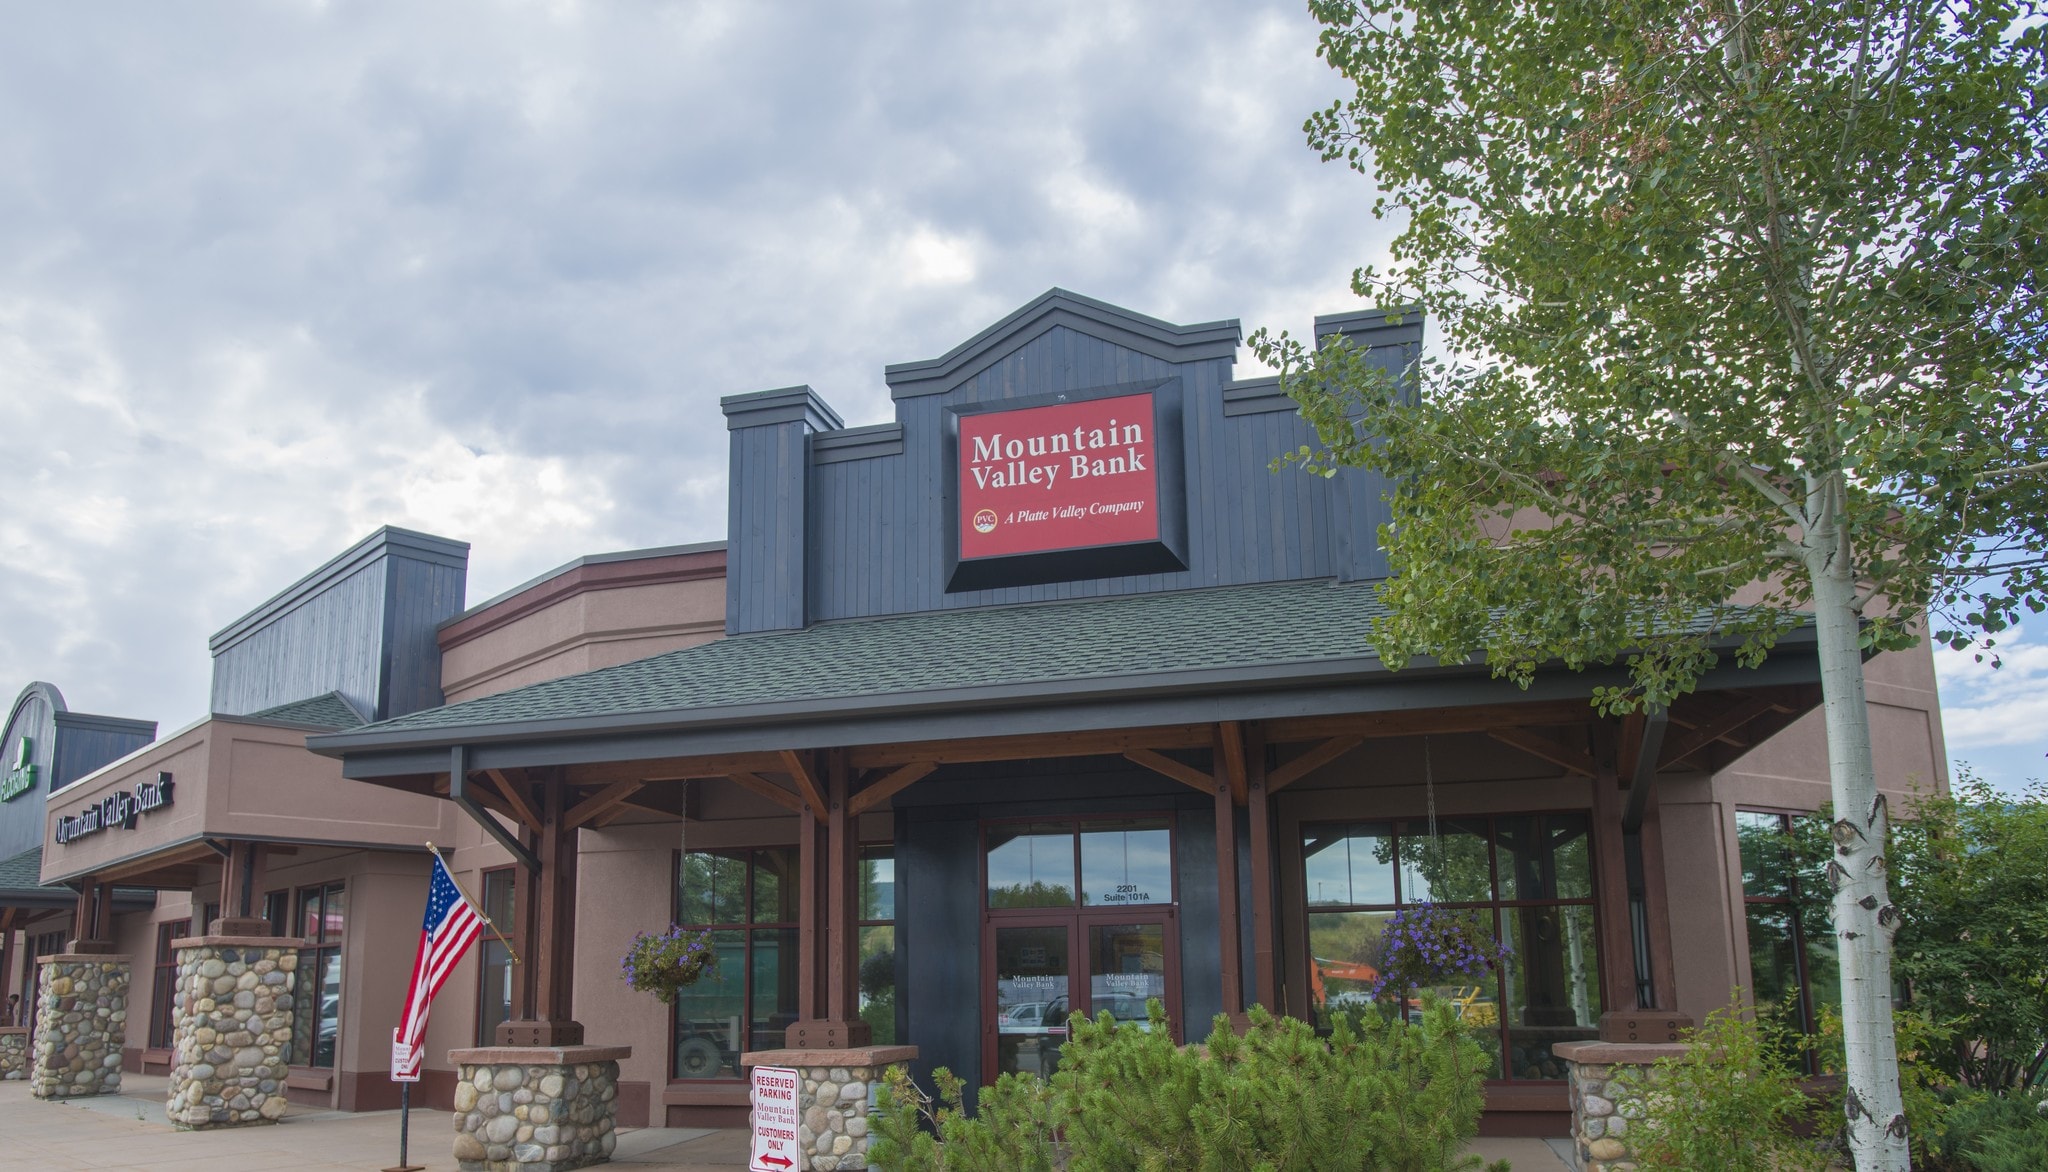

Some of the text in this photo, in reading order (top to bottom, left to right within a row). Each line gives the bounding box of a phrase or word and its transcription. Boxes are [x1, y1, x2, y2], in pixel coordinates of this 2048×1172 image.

[971, 419, 1144, 463] Mountain
[970, 447, 1147, 490] Valley Bank
[977, 514, 995, 524] PVC
[1004, 500, 1145, 524] A Platte Valley Company
[56, 771, 172, 844] Mountain Valley Bank
[1116, 884, 1138, 893] 2201
[1103, 892, 1150, 902] Suite 101A
[1012, 974, 1054, 982] Mountain
[1105, 973, 1149, 981] Mountain
[1105, 980, 1128, 988] Valley
[756, 1075, 795, 1089] RESERVED
[759, 1087, 792, 1101] PARKING
[757, 1102, 795, 1116] Mountain
[757, 1111, 796, 1125] Valley Bank
[757, 1126, 795, 1141] CUSTOMERS
[767, 1139, 784, 1151] ONLY
